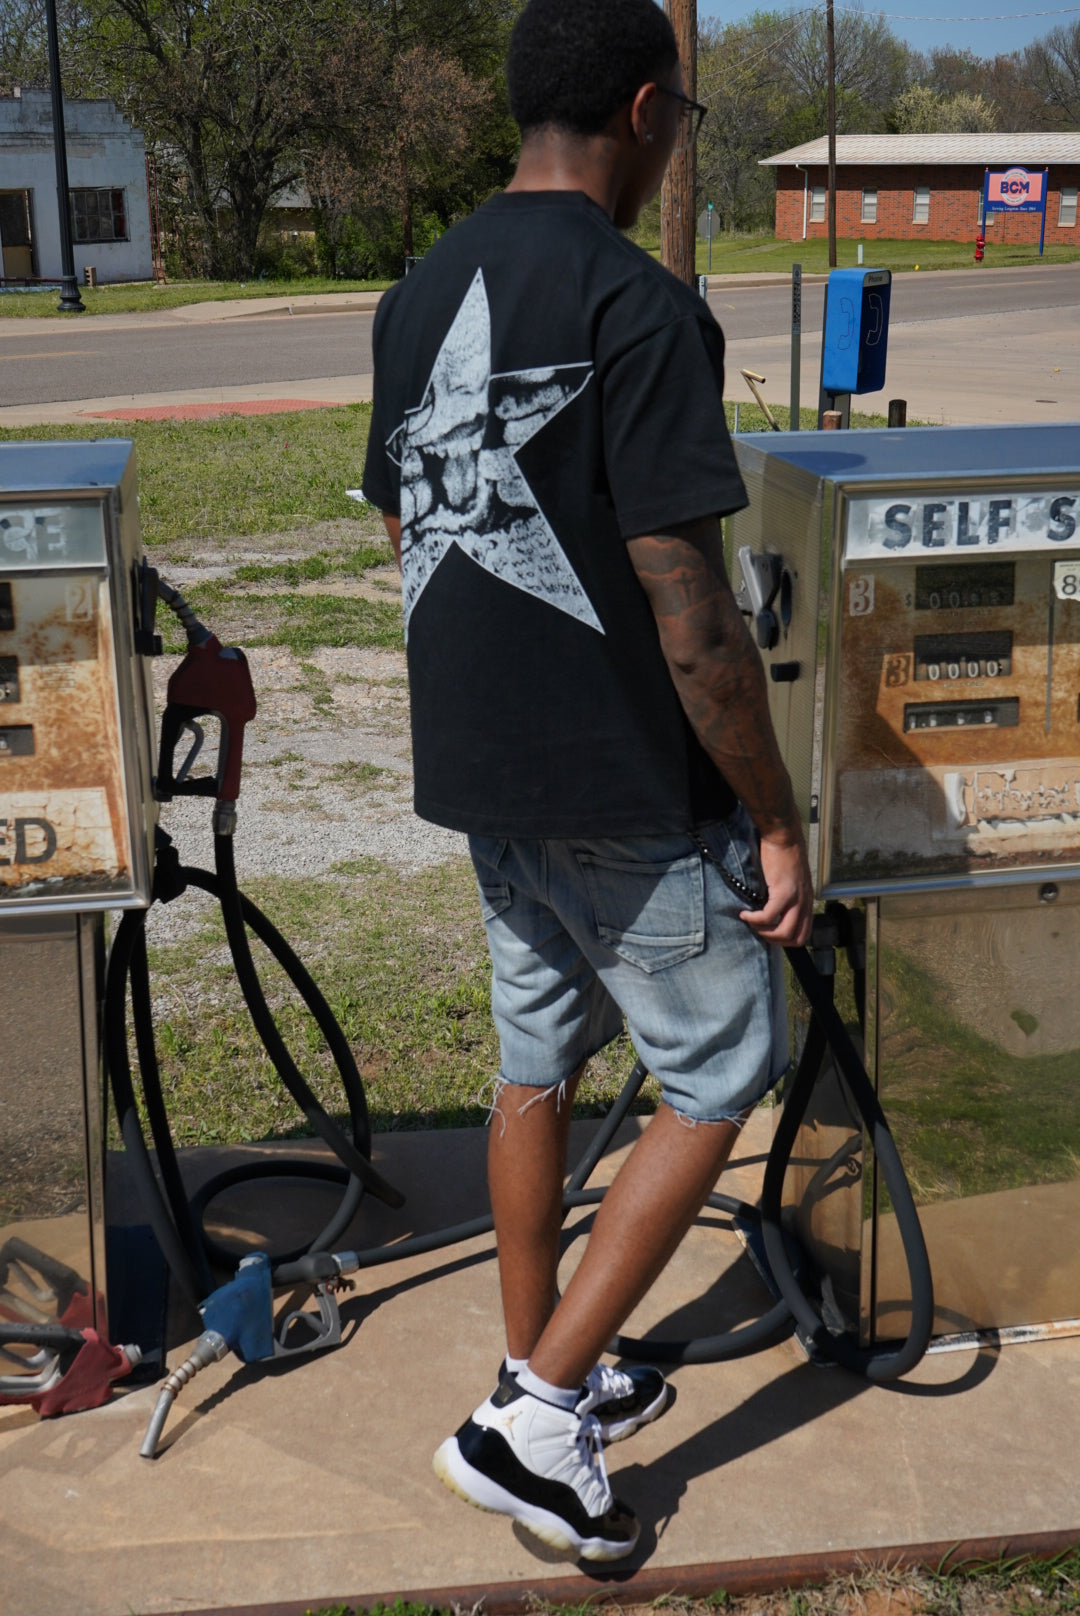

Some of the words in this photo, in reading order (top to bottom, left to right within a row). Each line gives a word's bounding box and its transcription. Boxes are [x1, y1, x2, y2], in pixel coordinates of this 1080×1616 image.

[1000, 181, 1030, 194] BCM
[868, 275, 883, 284] Phone
[882, 500, 1013, 550] SELF
[1061, 574, 1080, 596] 8
